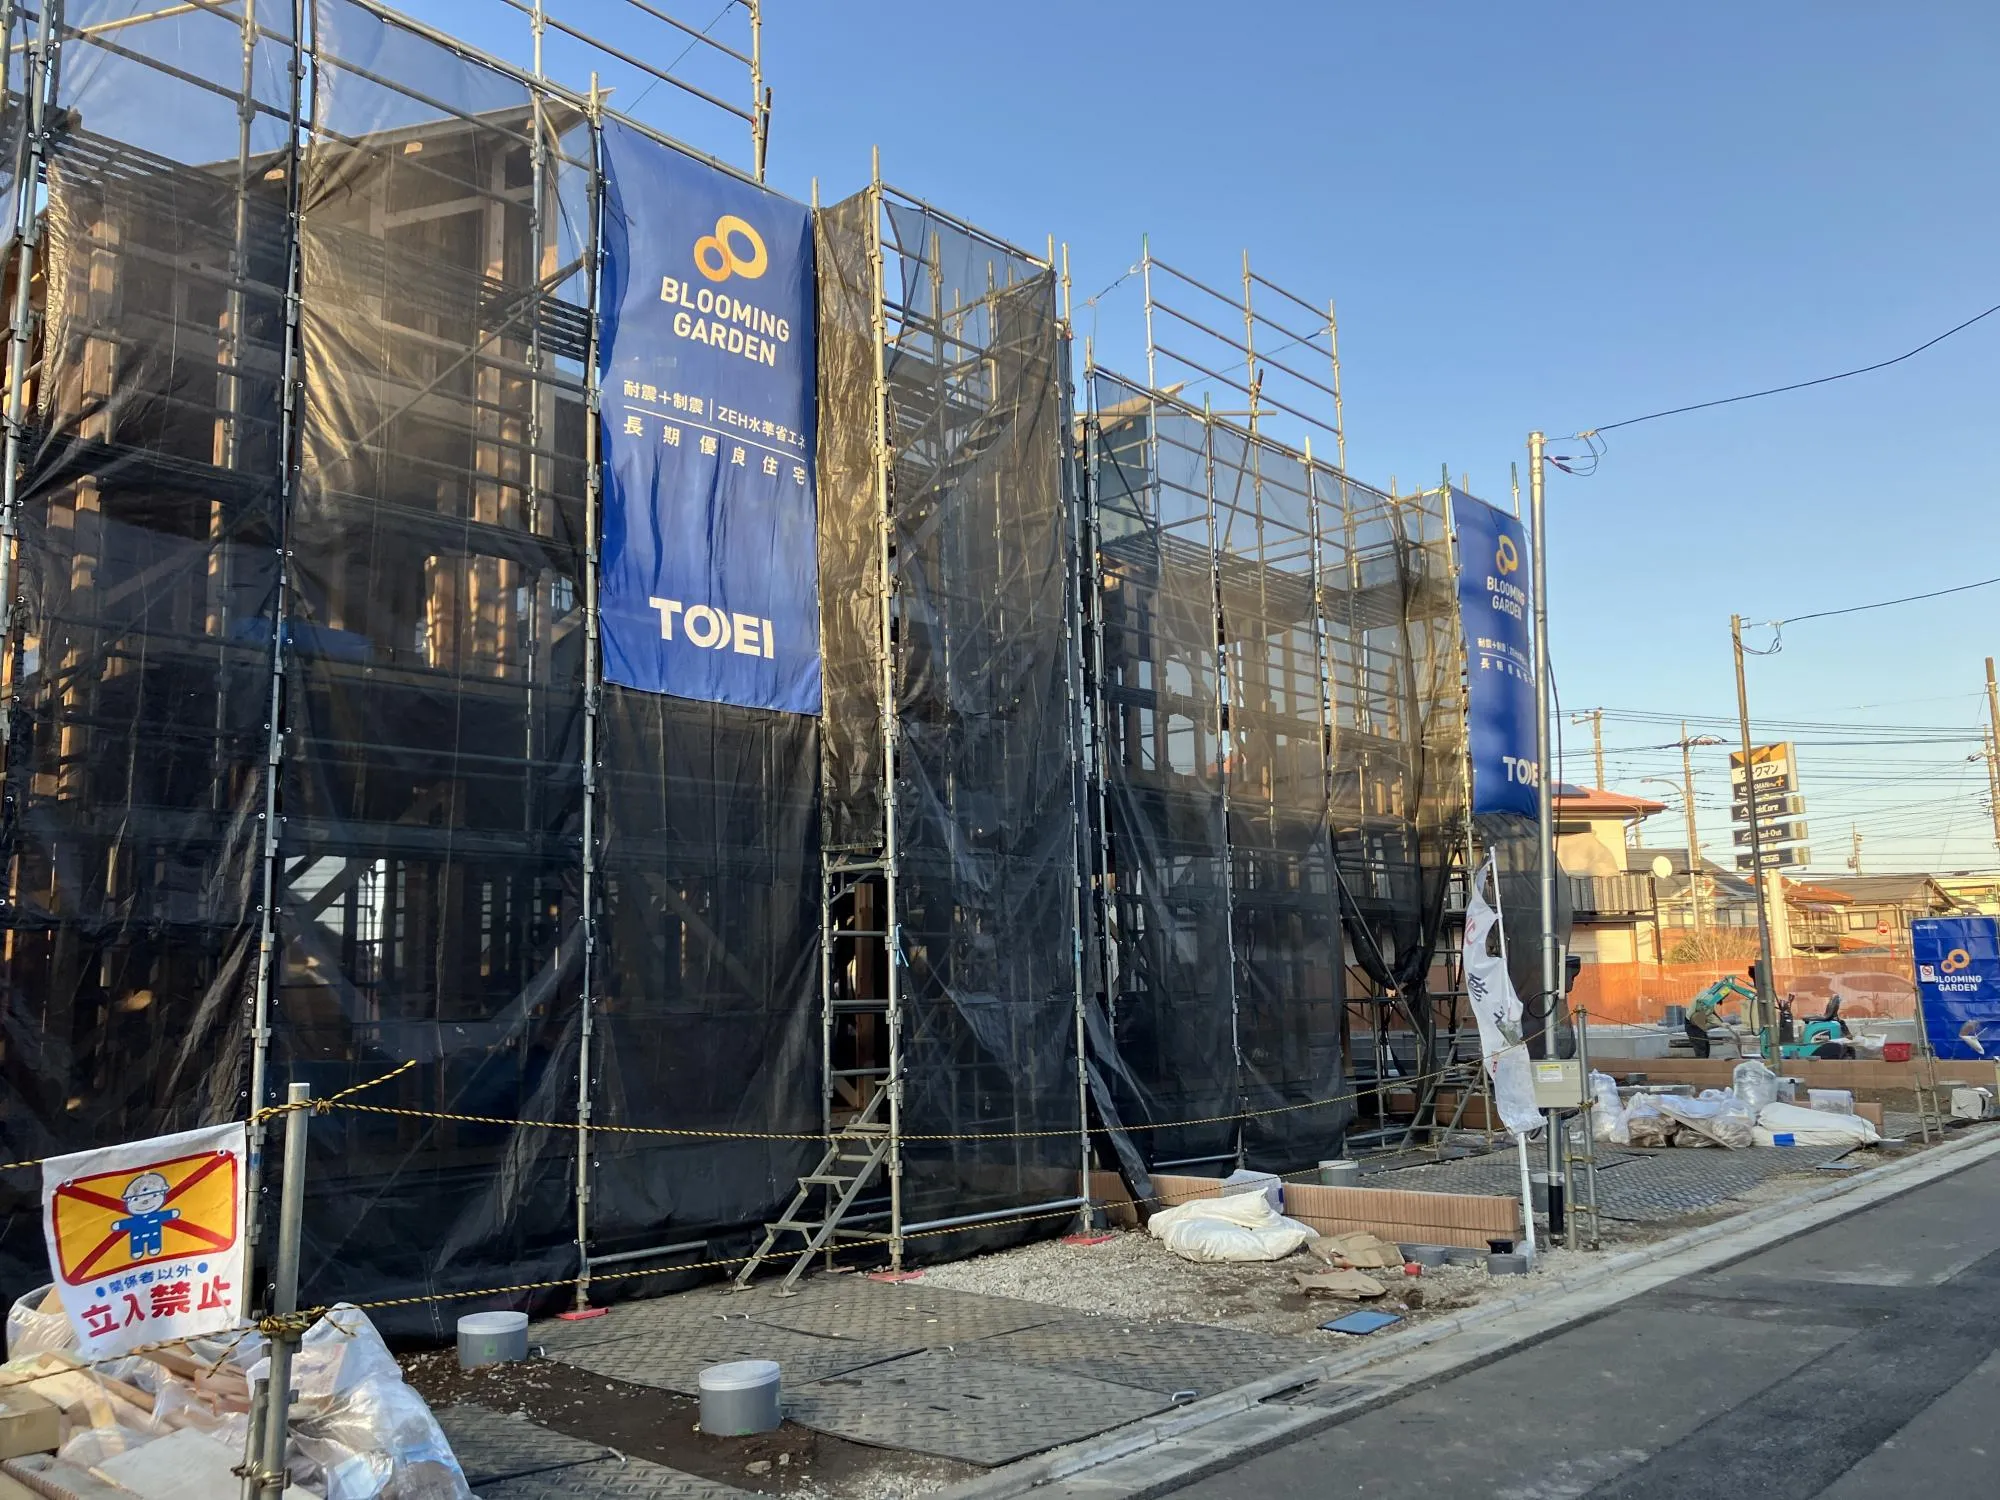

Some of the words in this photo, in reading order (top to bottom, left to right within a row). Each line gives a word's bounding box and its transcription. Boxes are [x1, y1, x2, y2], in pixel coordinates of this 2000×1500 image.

[660, 276, 790, 343] BLOOMING
[672, 312, 777, 368] GARDEN
[623, 415, 806, 485] 長期優良住宅
[717, 406, 806, 450] ZEH水準省エネ
[1486, 576, 1525, 605] BLOOMING
[1491, 595, 1523, 622] GARDEN
[648, 596, 775, 660] TOEI
[1502, 755, 1539, 788] TOE
[1938, 983, 1978, 992] GARDEN
[108, 1265, 193, 1294] 関係者以外
[81, 1275, 232, 1338] 立入禁止
